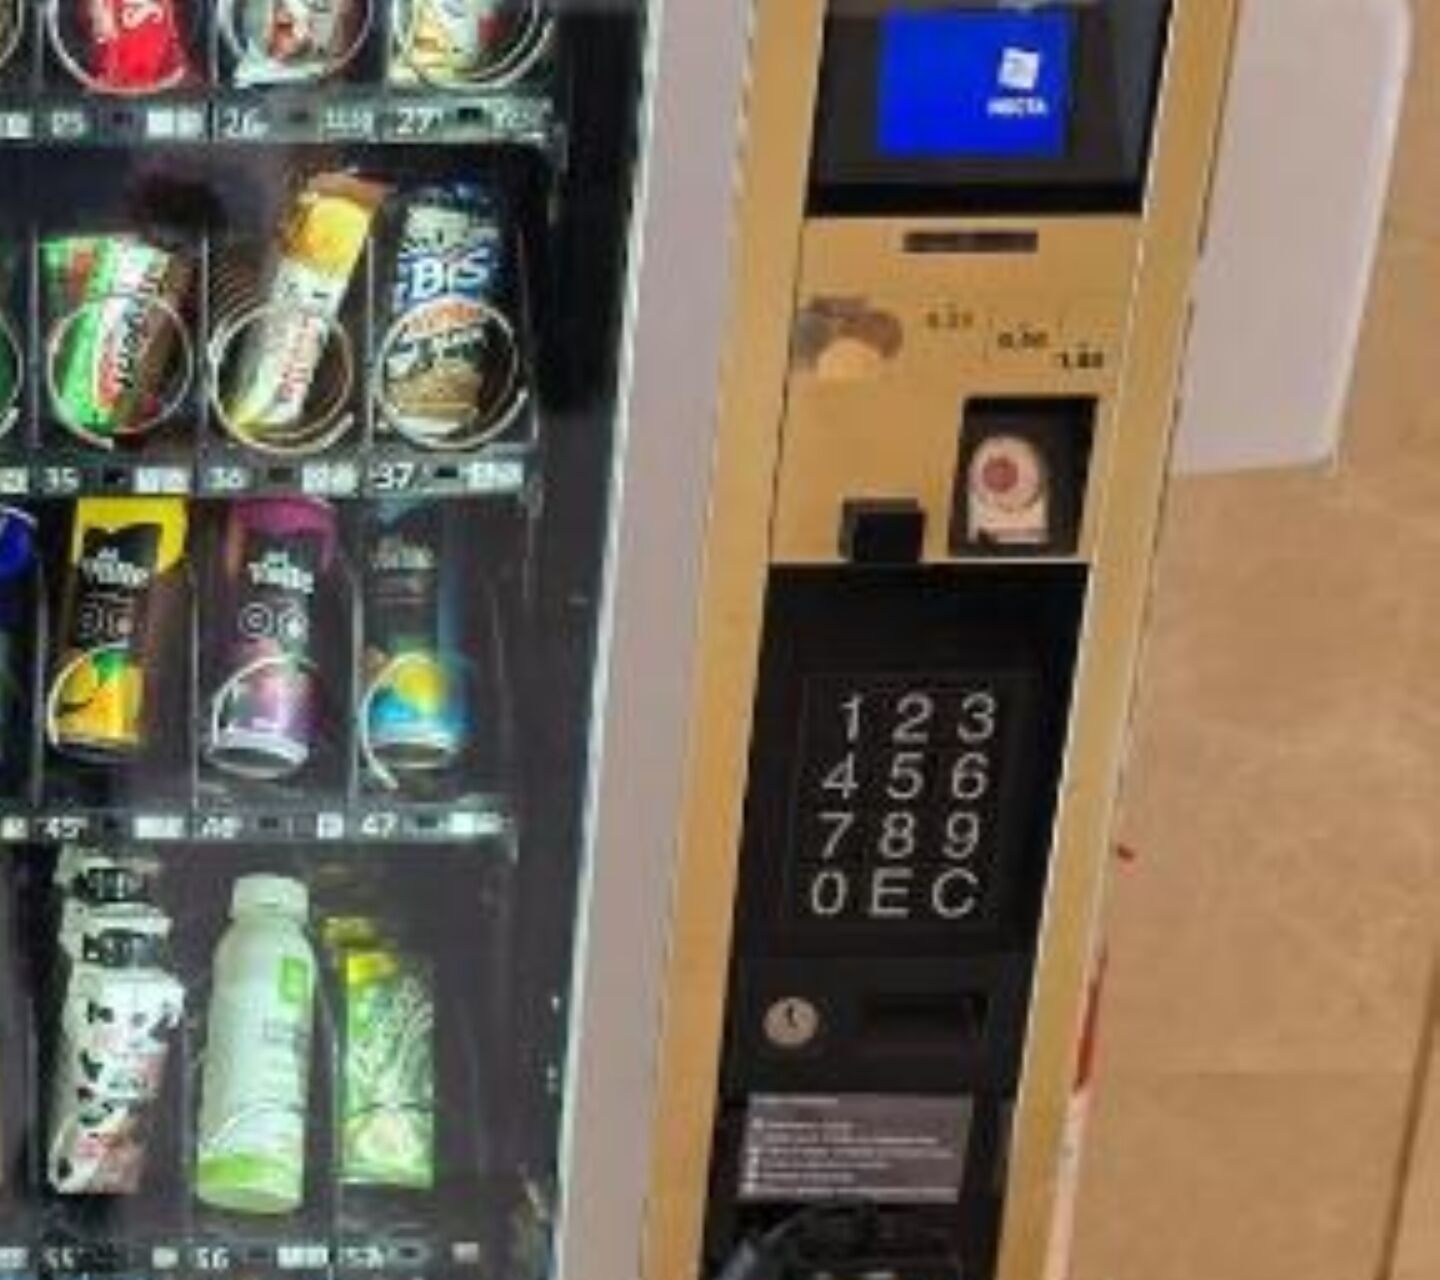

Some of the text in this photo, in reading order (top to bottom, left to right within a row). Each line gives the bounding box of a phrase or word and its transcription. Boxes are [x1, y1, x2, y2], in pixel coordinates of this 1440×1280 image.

[841, 691, 996, 744] 1 2 3
[822, 752, 989, 800] 4 5 6
[817, 810, 980, 860] 7 8 9
[811, 867, 979, 918] 0 E C
